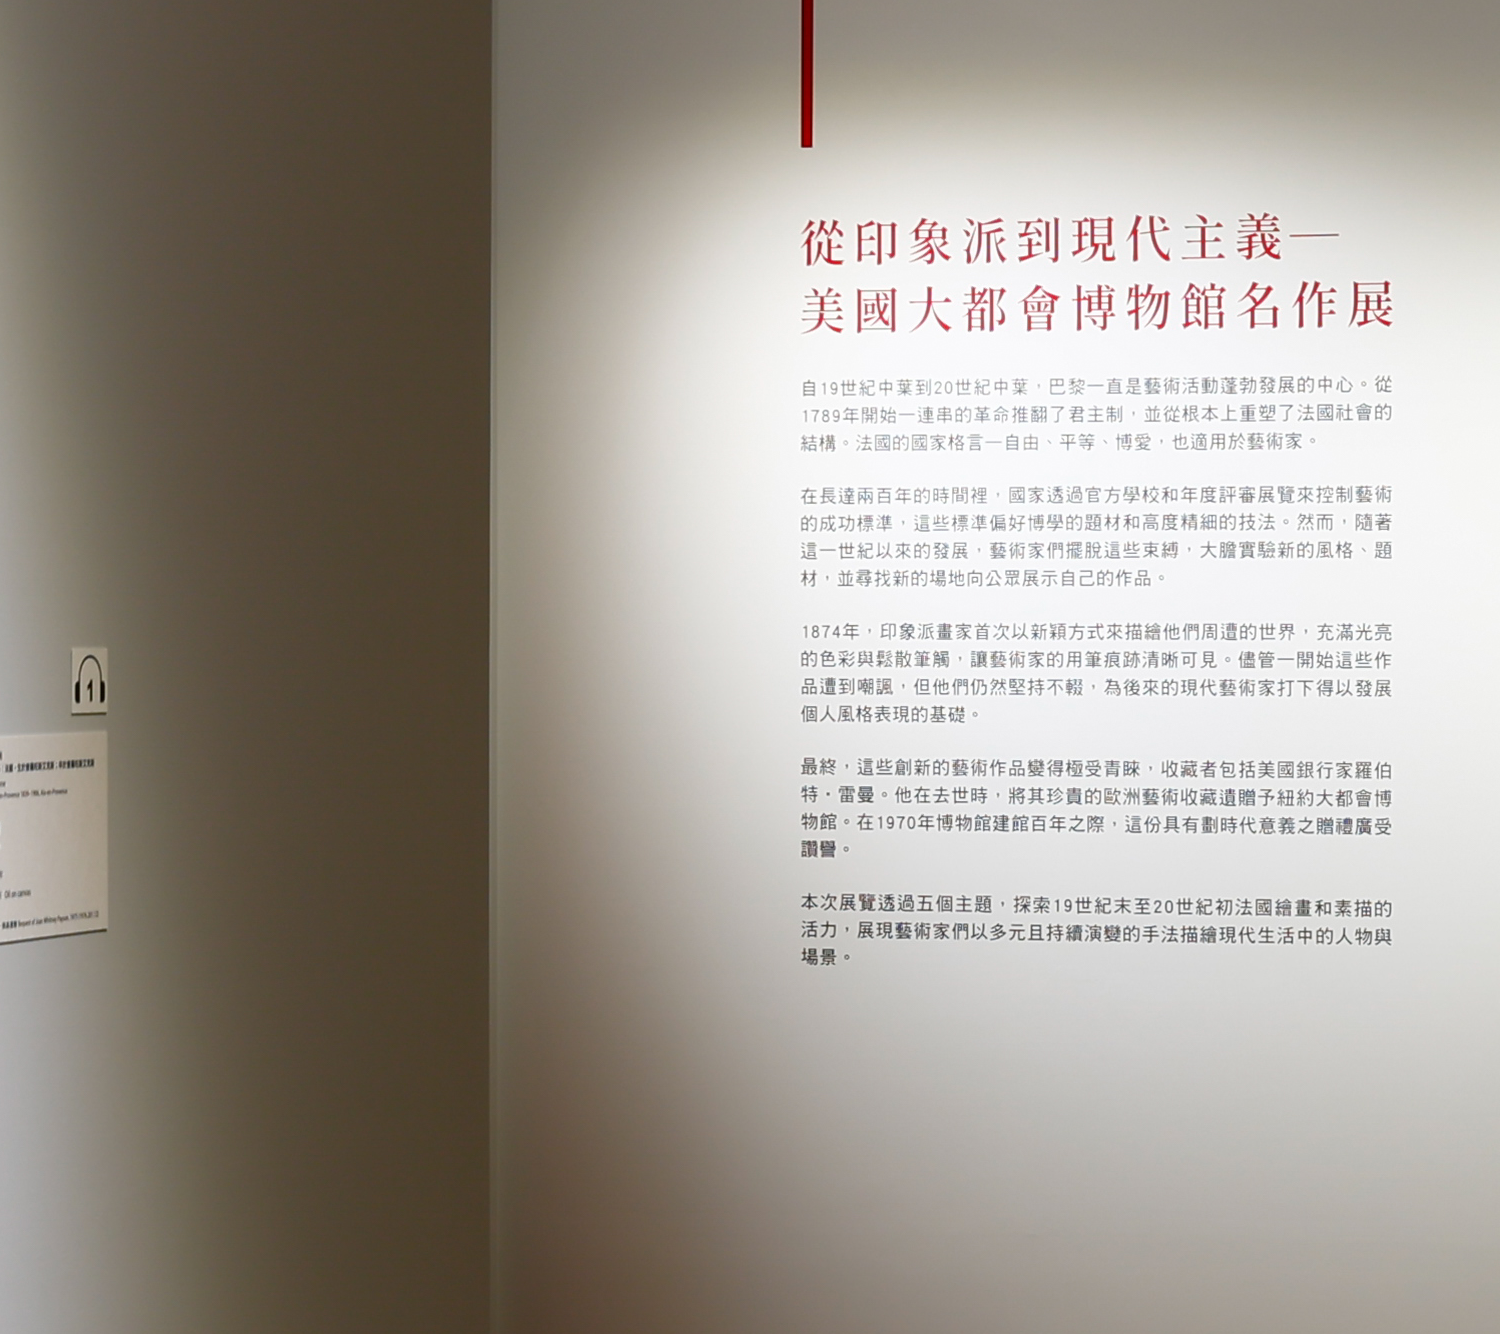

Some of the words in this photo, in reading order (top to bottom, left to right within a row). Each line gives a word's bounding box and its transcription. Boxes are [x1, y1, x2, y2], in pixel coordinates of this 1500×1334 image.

[801, 280, 1393, 335] 美國大都會博物館名作展
[86, 678, 94, 703] 1
